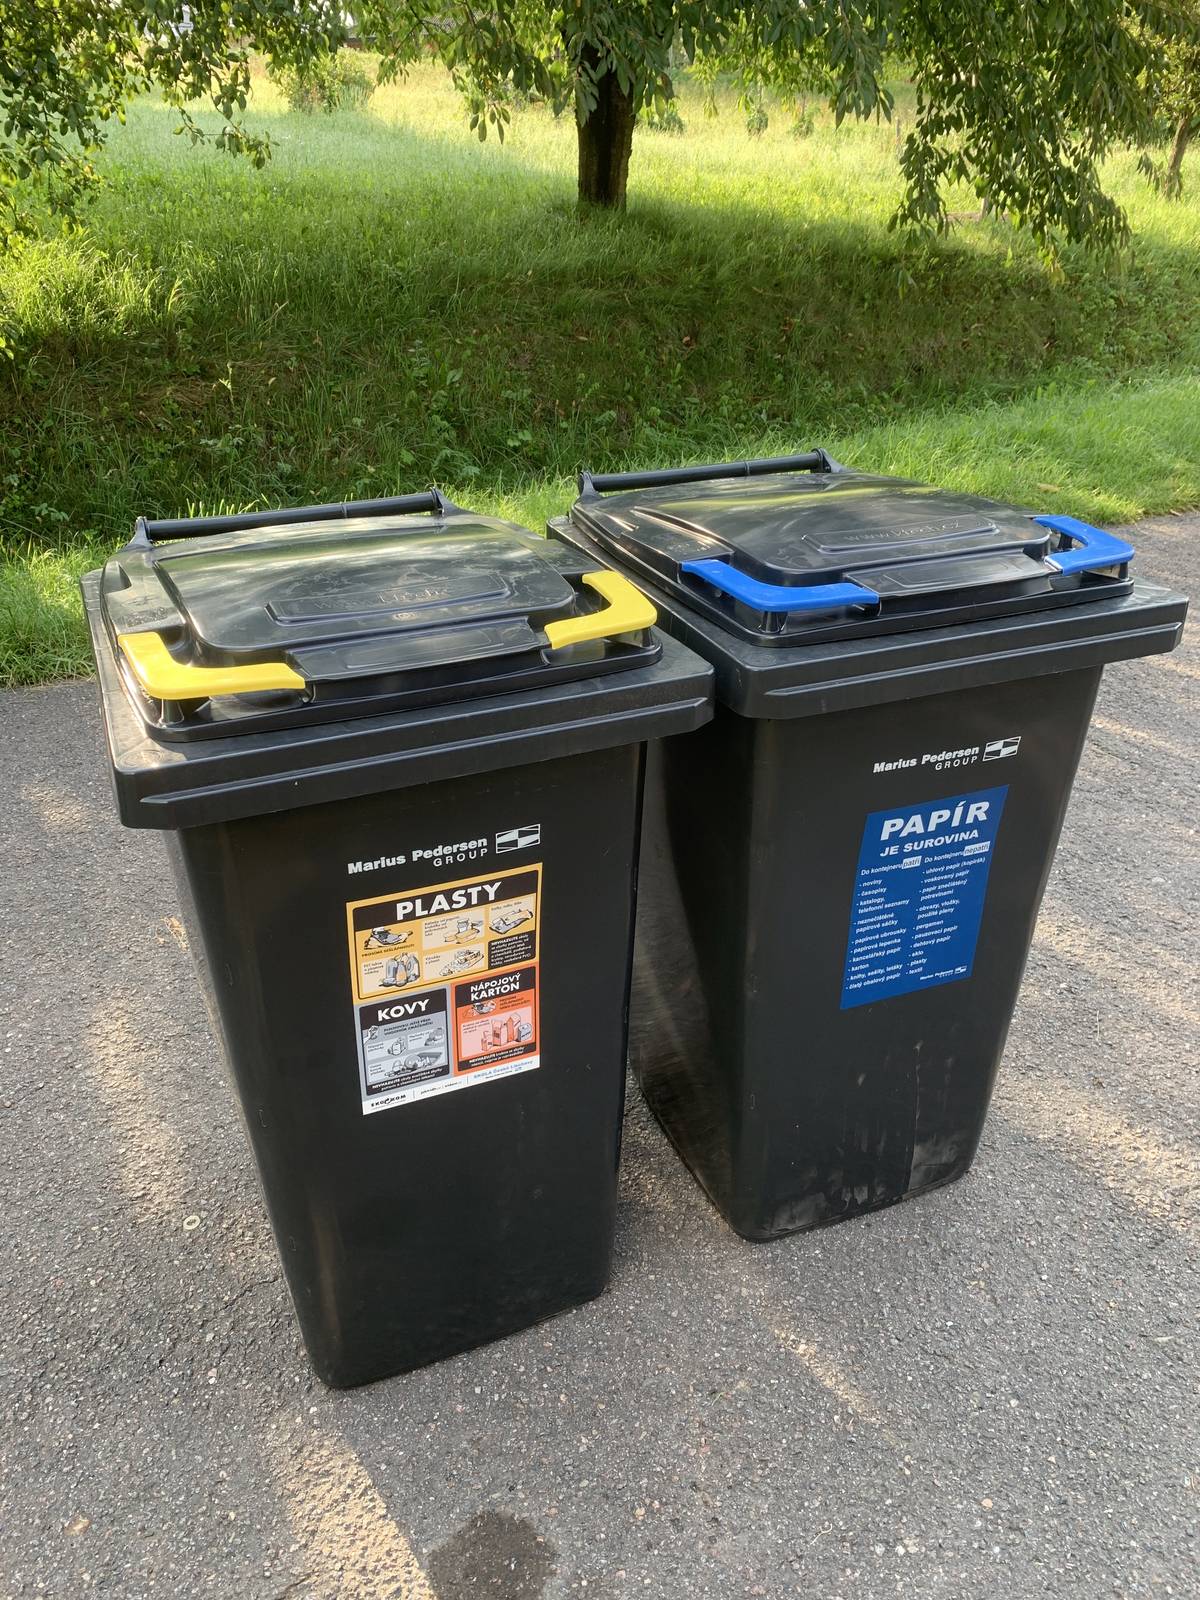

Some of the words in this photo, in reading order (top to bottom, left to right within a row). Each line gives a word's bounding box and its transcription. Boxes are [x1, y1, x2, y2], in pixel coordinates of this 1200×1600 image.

[873, 758, 917, 773] Marius
[922, 746, 979, 764] Pedersen
[935, 756, 978, 771] GROUP
[880, 801, 990, 840] PAPÍR
[880, 846, 899, 857] JE
[903, 830, 979, 852] SUROVINA
[348, 854, 406, 875] Marius
[412, 838, 488, 861] Pedersen
[433, 848, 488, 867] GROUP
[862, 878, 881, 888] noviny
[397, 882, 501, 920] PLASTY
[851, 963, 869, 971] karton
[471, 974, 521, 992] NÁPOJOVÝ
[471, 982, 520, 1001] KARTON
[378, 999, 430, 1021] KOVY
